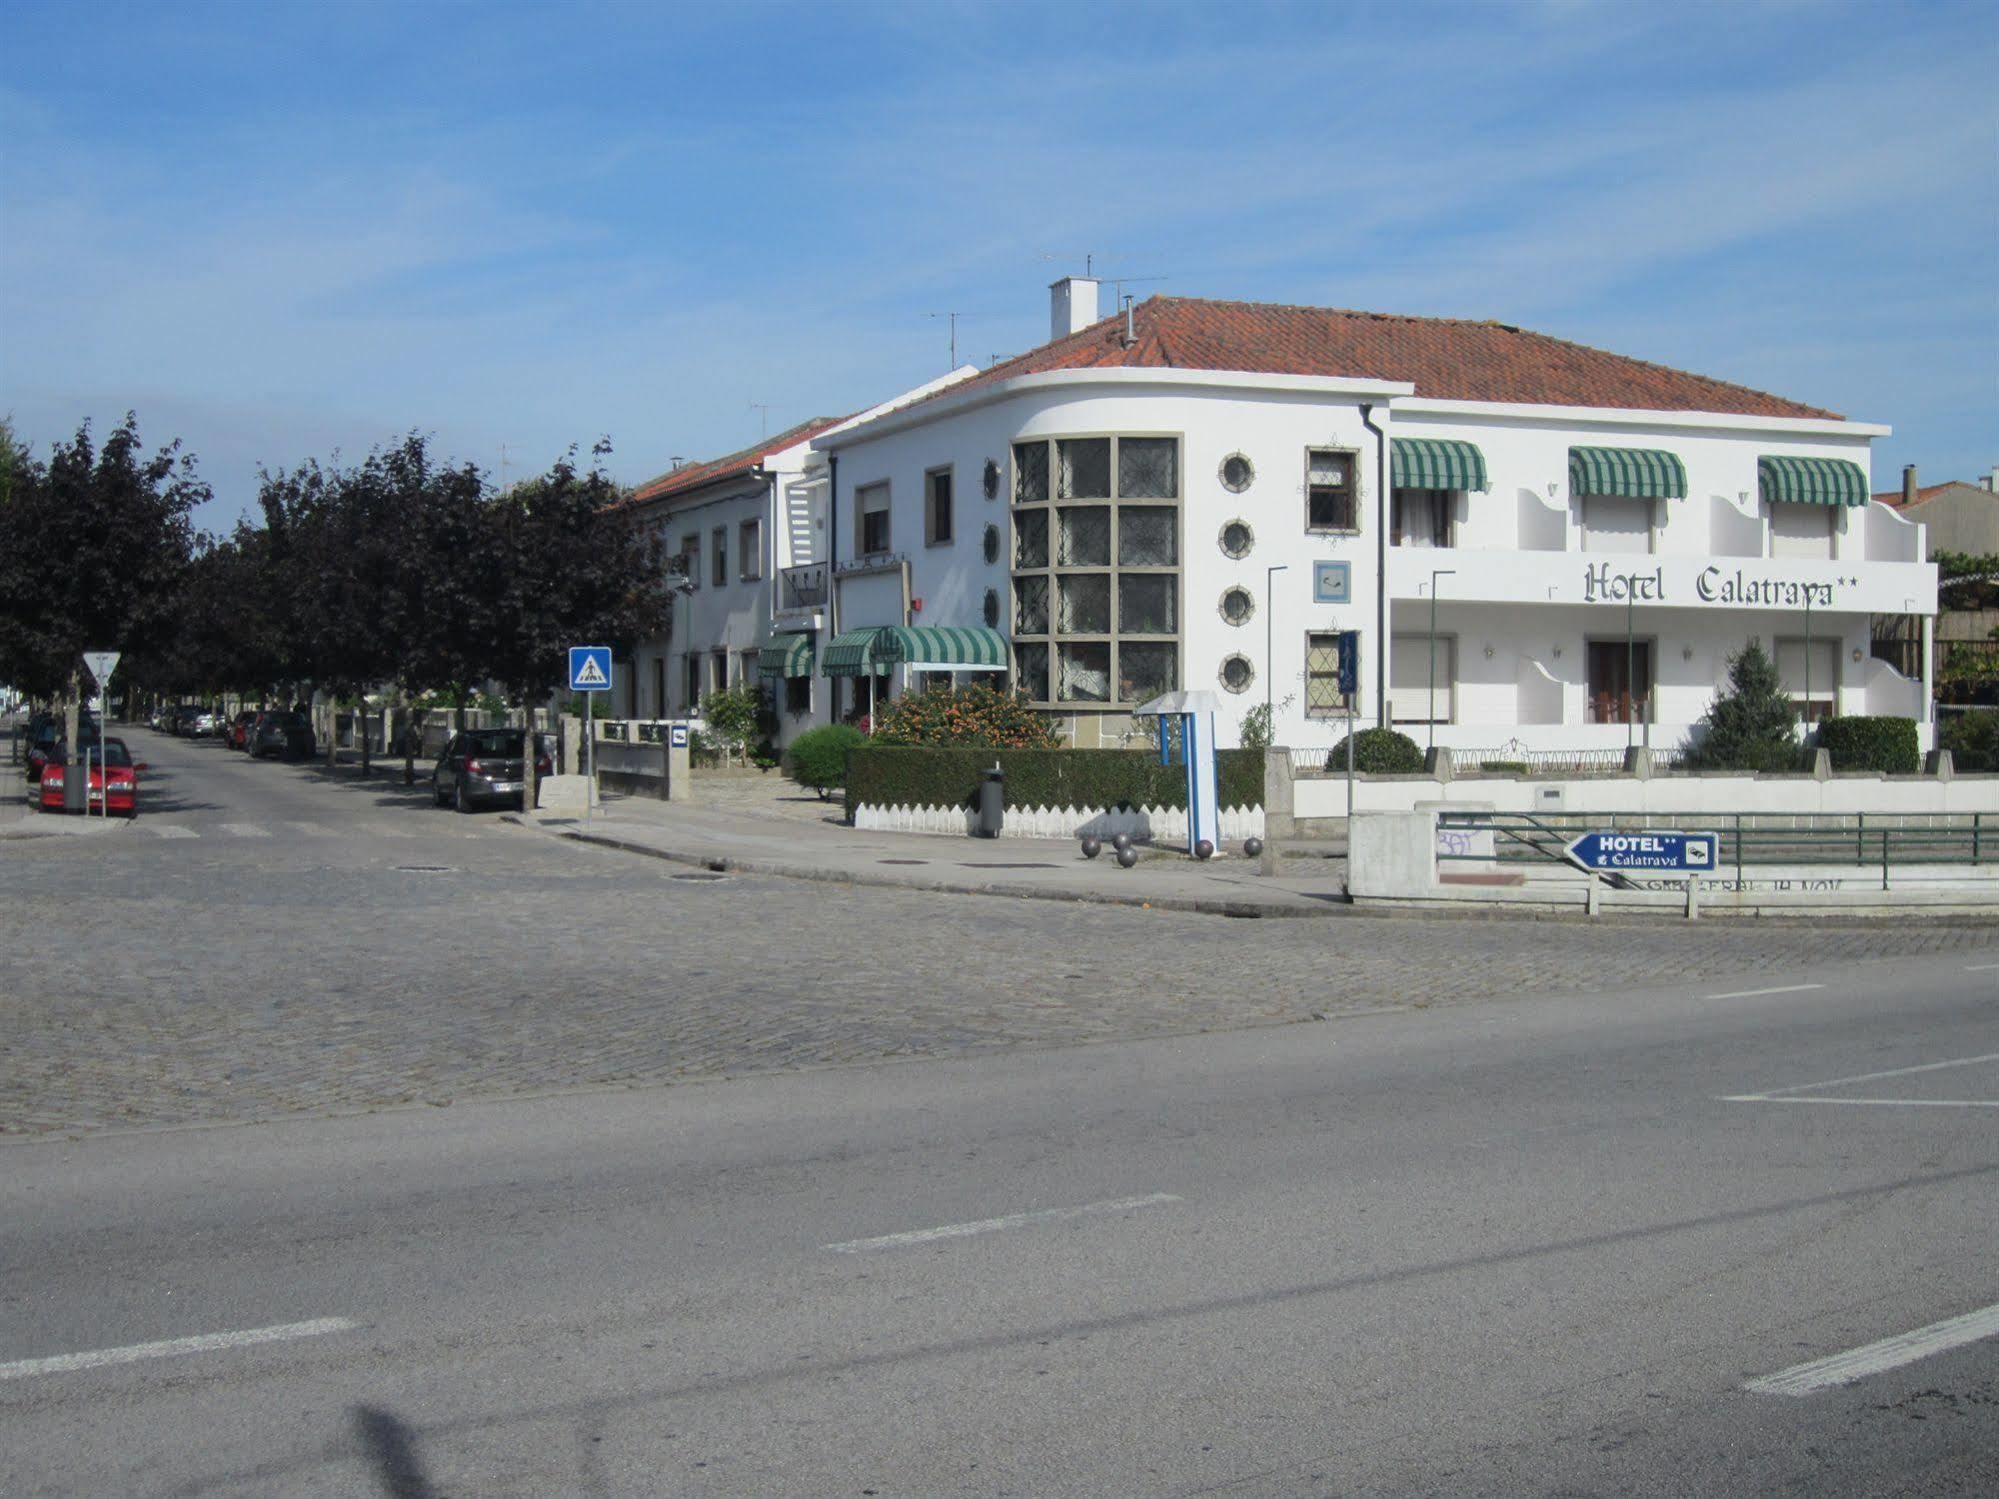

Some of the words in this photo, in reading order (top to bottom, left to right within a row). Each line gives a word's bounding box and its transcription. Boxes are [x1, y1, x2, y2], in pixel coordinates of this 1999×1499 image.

[1584, 562, 1665, 602] Hotel
[1696, 566, 1833, 606] Calatrava
[1600, 837, 1664, 852] HOTEL
[1612, 853, 1678, 867] Calatrava
